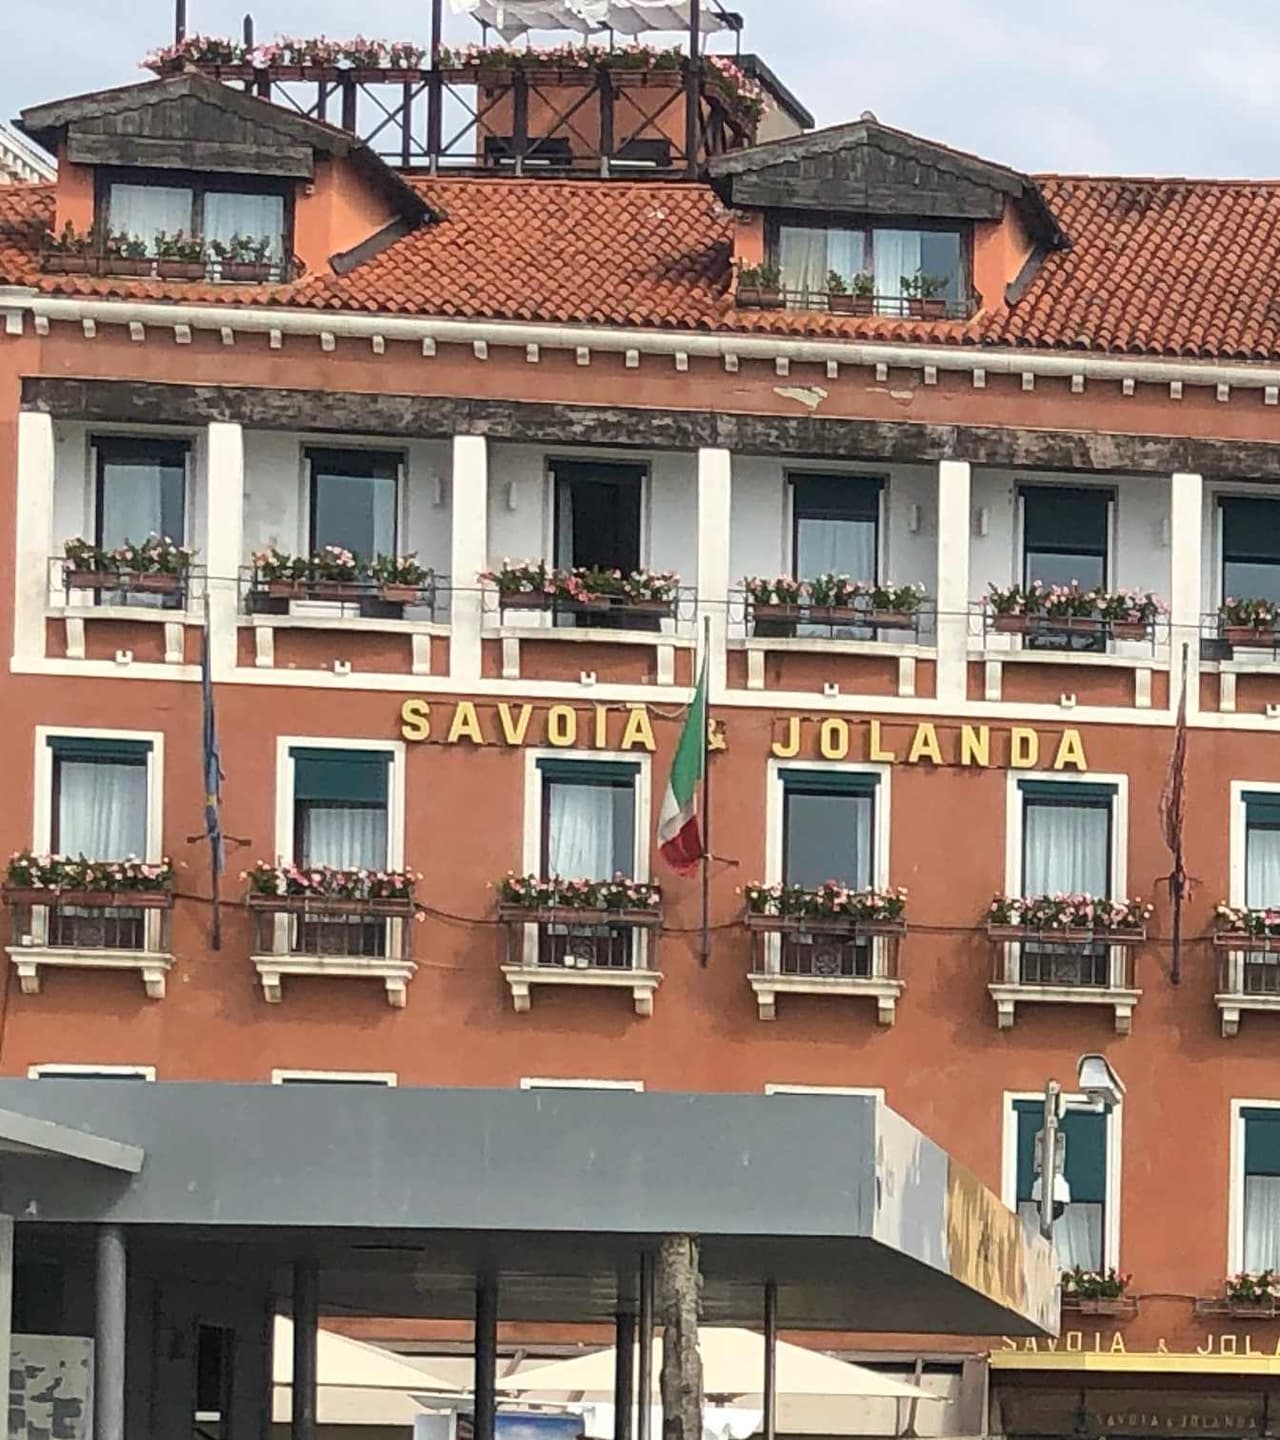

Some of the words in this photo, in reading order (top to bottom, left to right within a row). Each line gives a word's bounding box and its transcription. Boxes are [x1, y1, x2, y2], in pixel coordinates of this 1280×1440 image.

[400, 698, 656, 750] SAVOIA
[771, 716, 1087, 770] JOLANDA
[1001, 1331, 1126, 1353] SAVOIA
